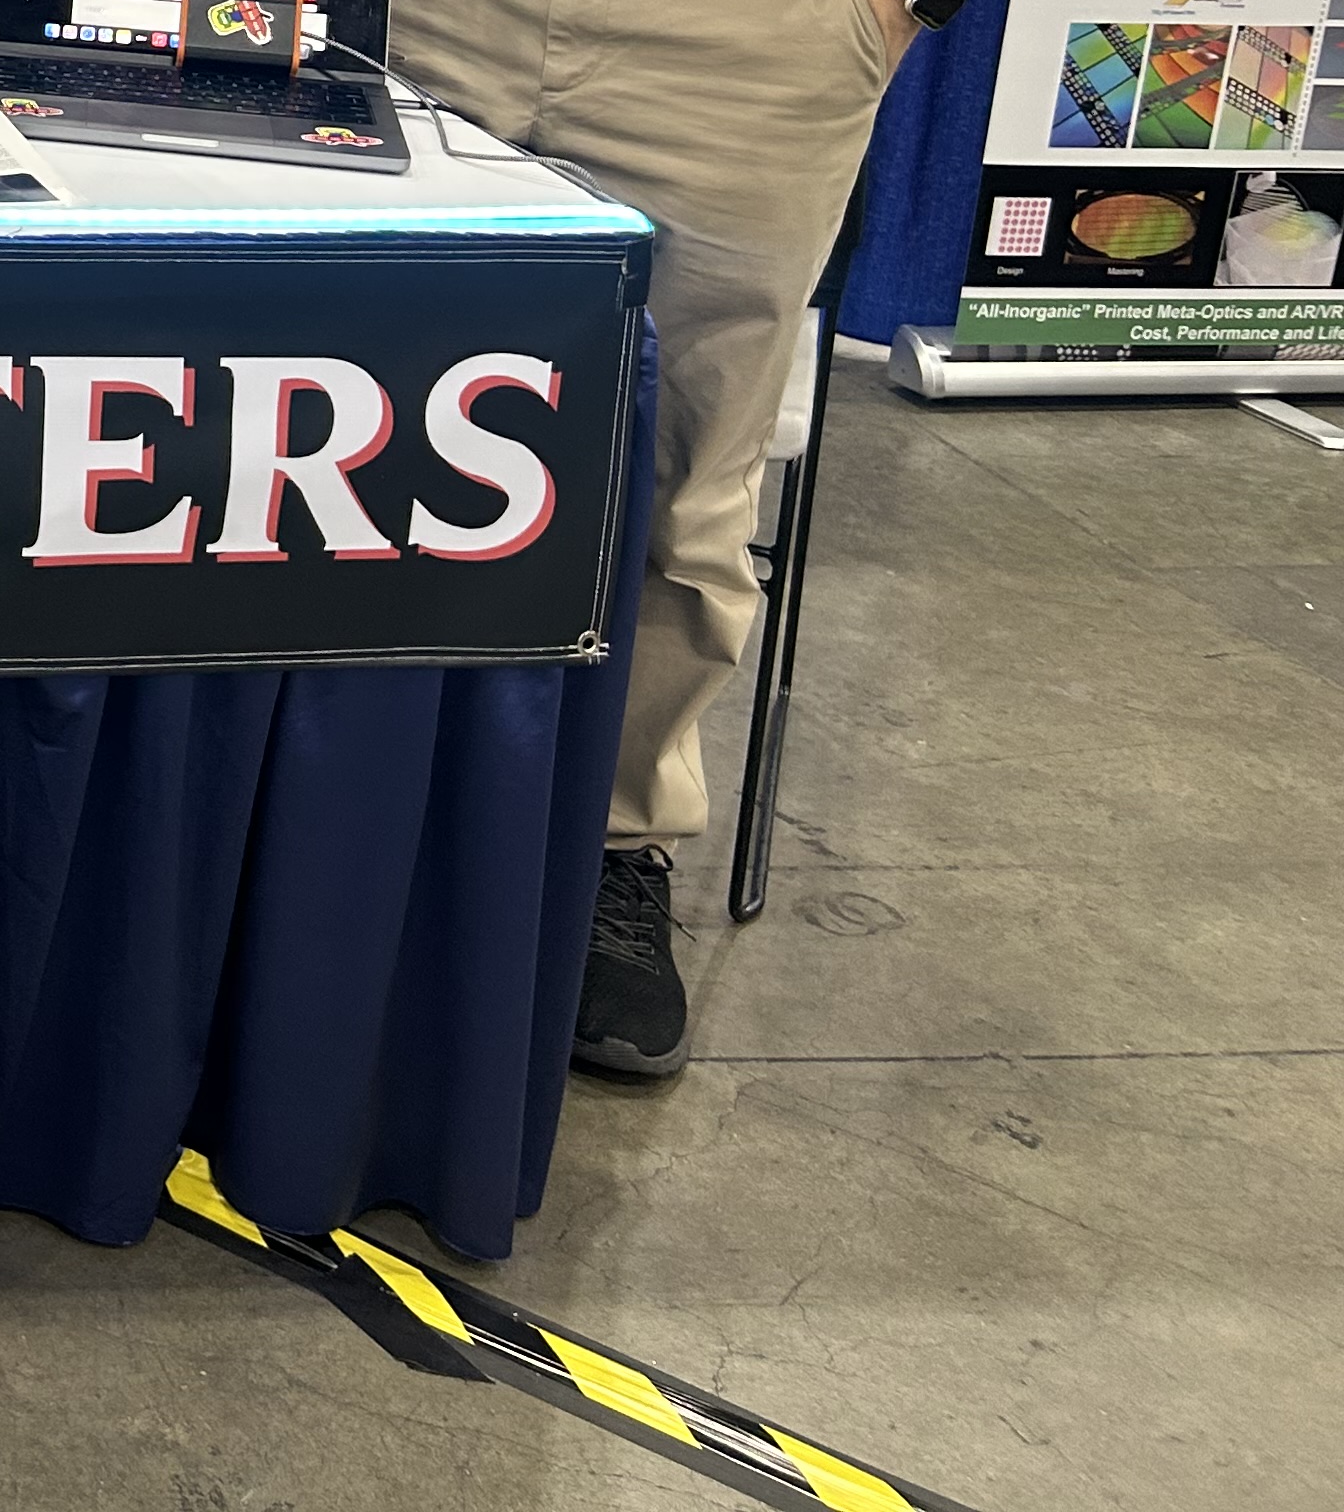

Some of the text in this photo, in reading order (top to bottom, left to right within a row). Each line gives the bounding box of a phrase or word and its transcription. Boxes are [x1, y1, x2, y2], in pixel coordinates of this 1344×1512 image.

[997, 267, 1024, 276] Design
[1094, 304, 1152, 319] Printed
[1157, 304, 1253, 322] Meta-Optics
[1257, 306, 1287, 318] and
[1290, 306, 1344, 320] AR/VR
[1130, 325, 1172, 342] Cost,
[1177, 326, 1280, 340] Performance
[1284, 327, 1314, 340] and
